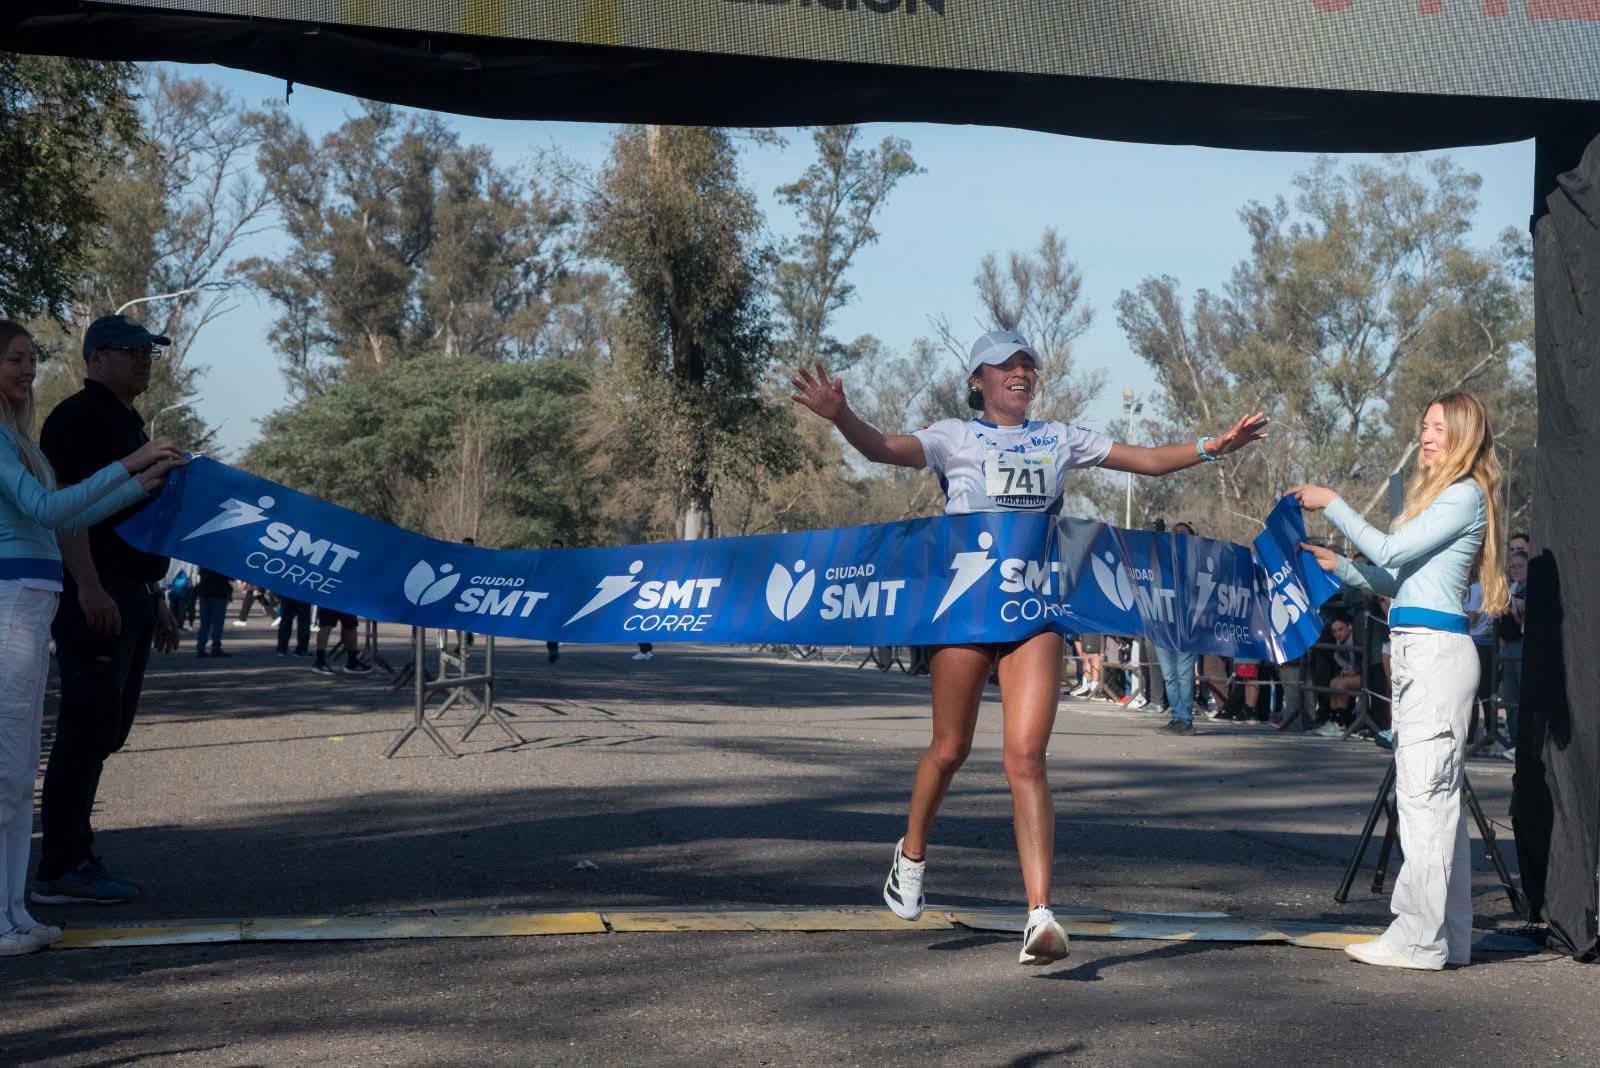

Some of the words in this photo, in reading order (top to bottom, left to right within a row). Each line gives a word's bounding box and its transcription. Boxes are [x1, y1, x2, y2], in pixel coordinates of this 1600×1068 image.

[999, 467, 1046, 494] 741
[258, 521, 361, 573] SMT
[245, 551, 343, 594] CORRE
[470, 575, 525, 587] CIUDAD
[825, 563, 876, 581] CIUDAD
[454, 587, 550, 618] SMT
[633, 577, 722, 610] SMT
[819, 579, 906, 620] SMT
[1135, 585, 1176, 623] MT
[1217, 583, 1252, 619] SMT
[623, 614, 713, 632] CORRE
